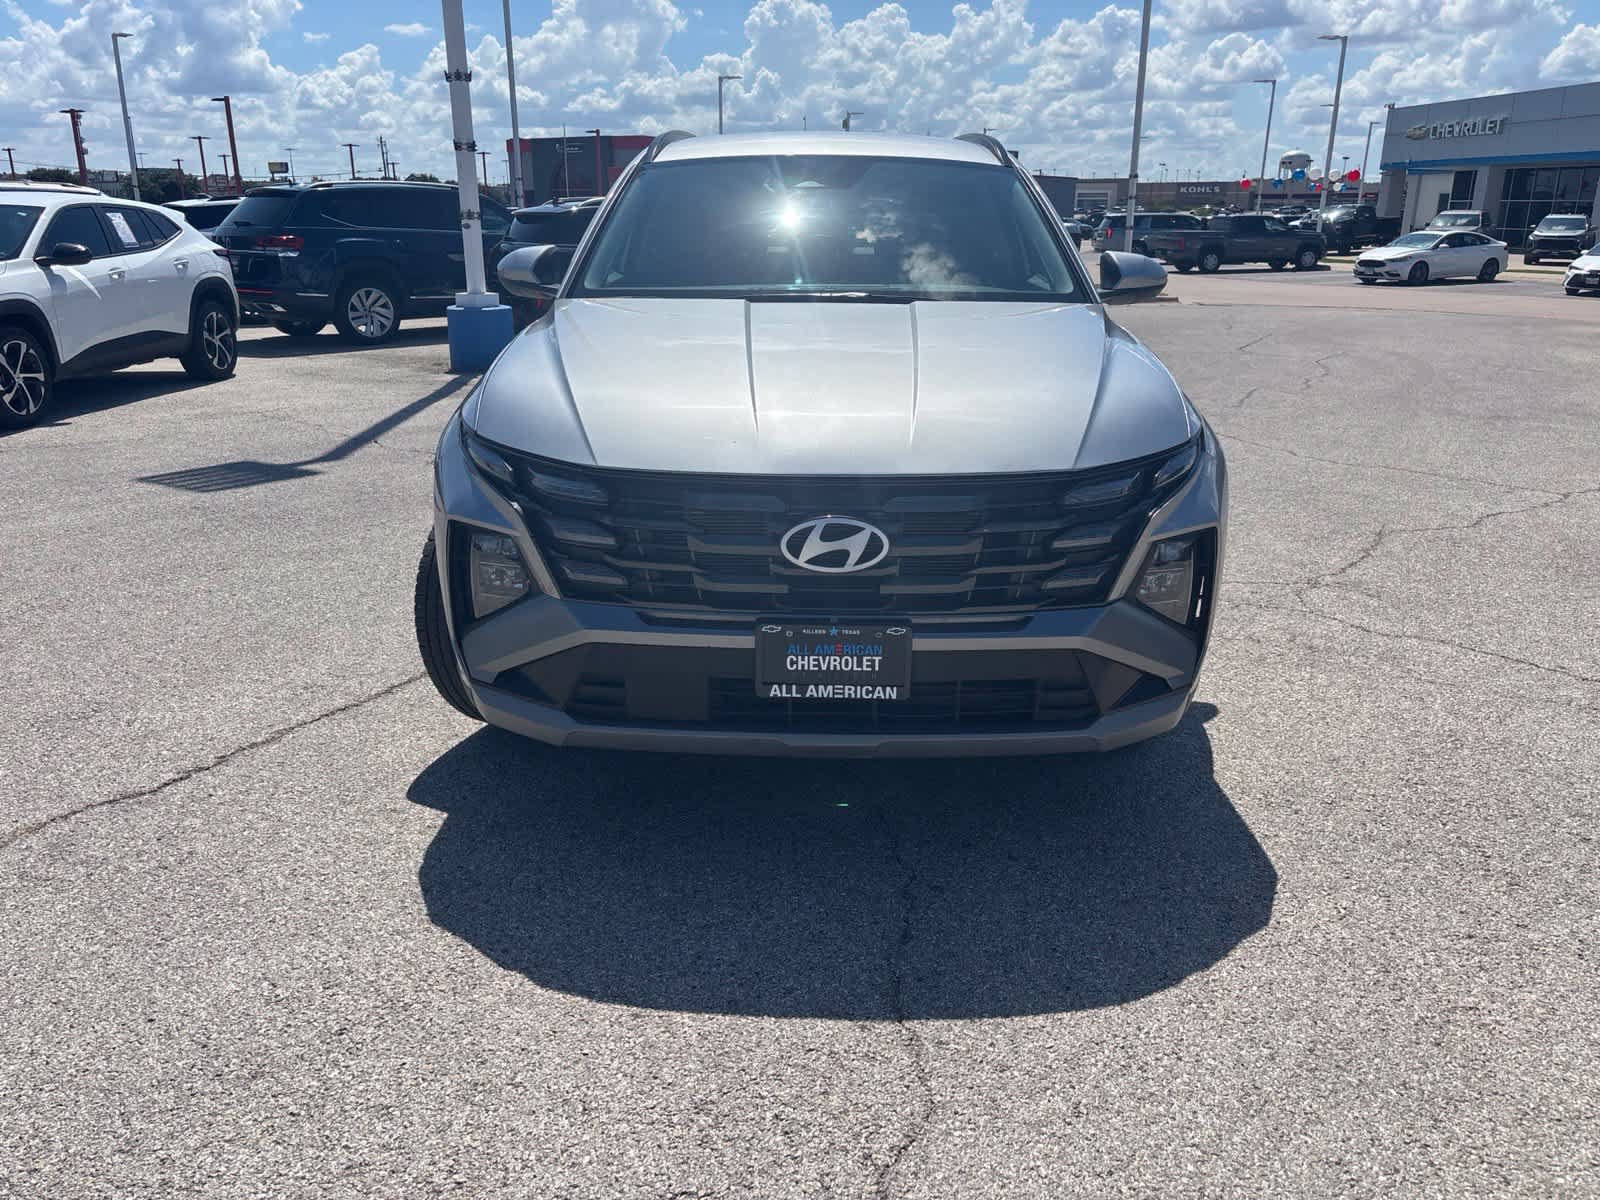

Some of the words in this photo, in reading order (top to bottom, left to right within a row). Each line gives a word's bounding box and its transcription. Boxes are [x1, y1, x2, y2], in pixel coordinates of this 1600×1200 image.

[1430, 116, 1507, 139] CHEVROLET
[787, 644, 810, 655] ALL
[815, 643, 882, 656] AMERICAN
[786, 656, 882, 671] CHEVROLET
[769, 685, 801, 697] ALL
[806, 685, 897, 699] AMERICAN
